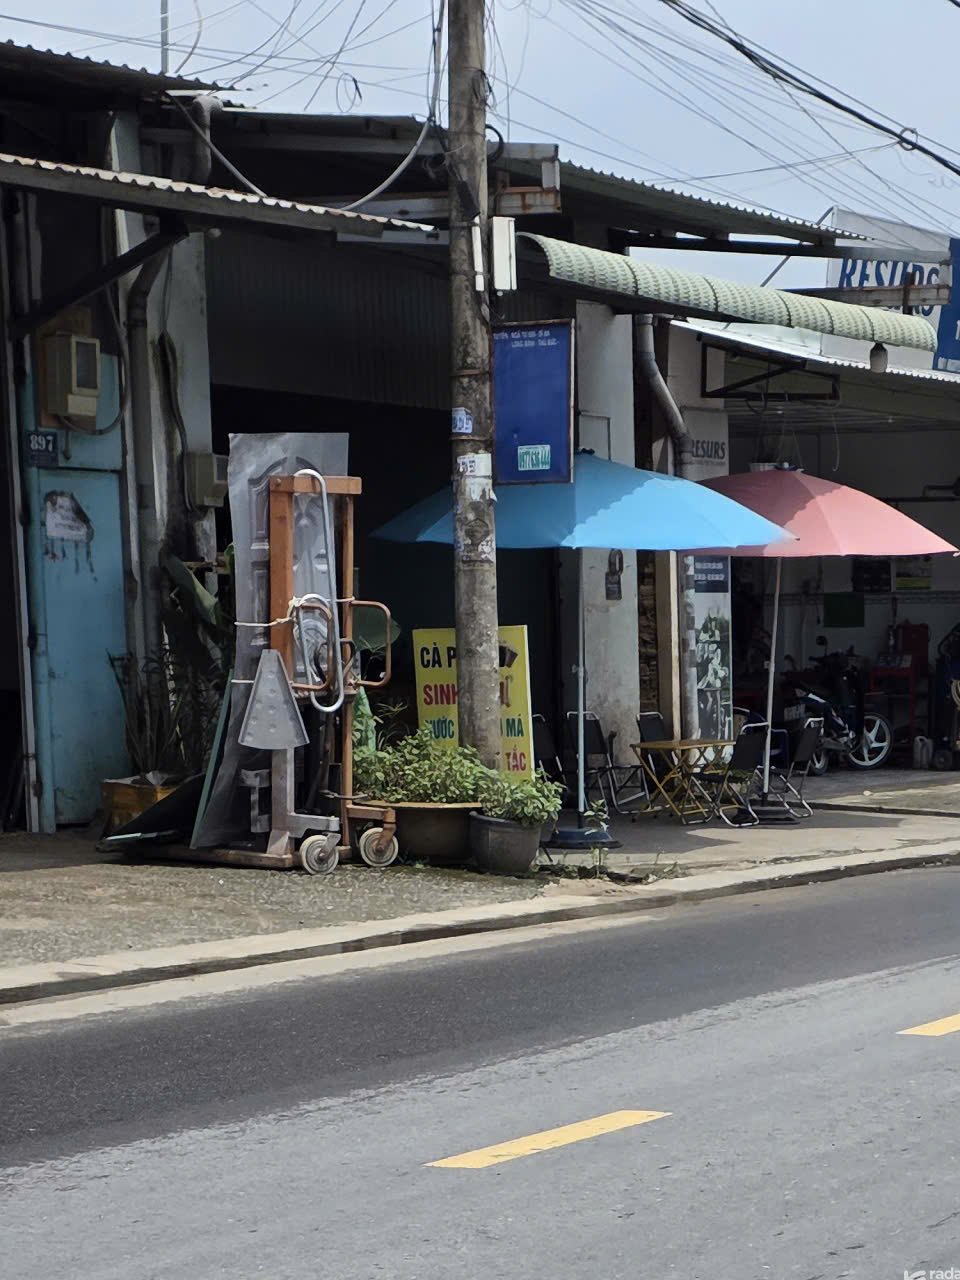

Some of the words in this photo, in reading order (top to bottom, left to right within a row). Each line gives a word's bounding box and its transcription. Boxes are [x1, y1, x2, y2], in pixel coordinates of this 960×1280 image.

[30, 434, 54, 452] 897
[420, 641, 442, 669] CÀ
[505, 713, 524, 737] MÁ
[505, 745, 527, 771] TẮC
